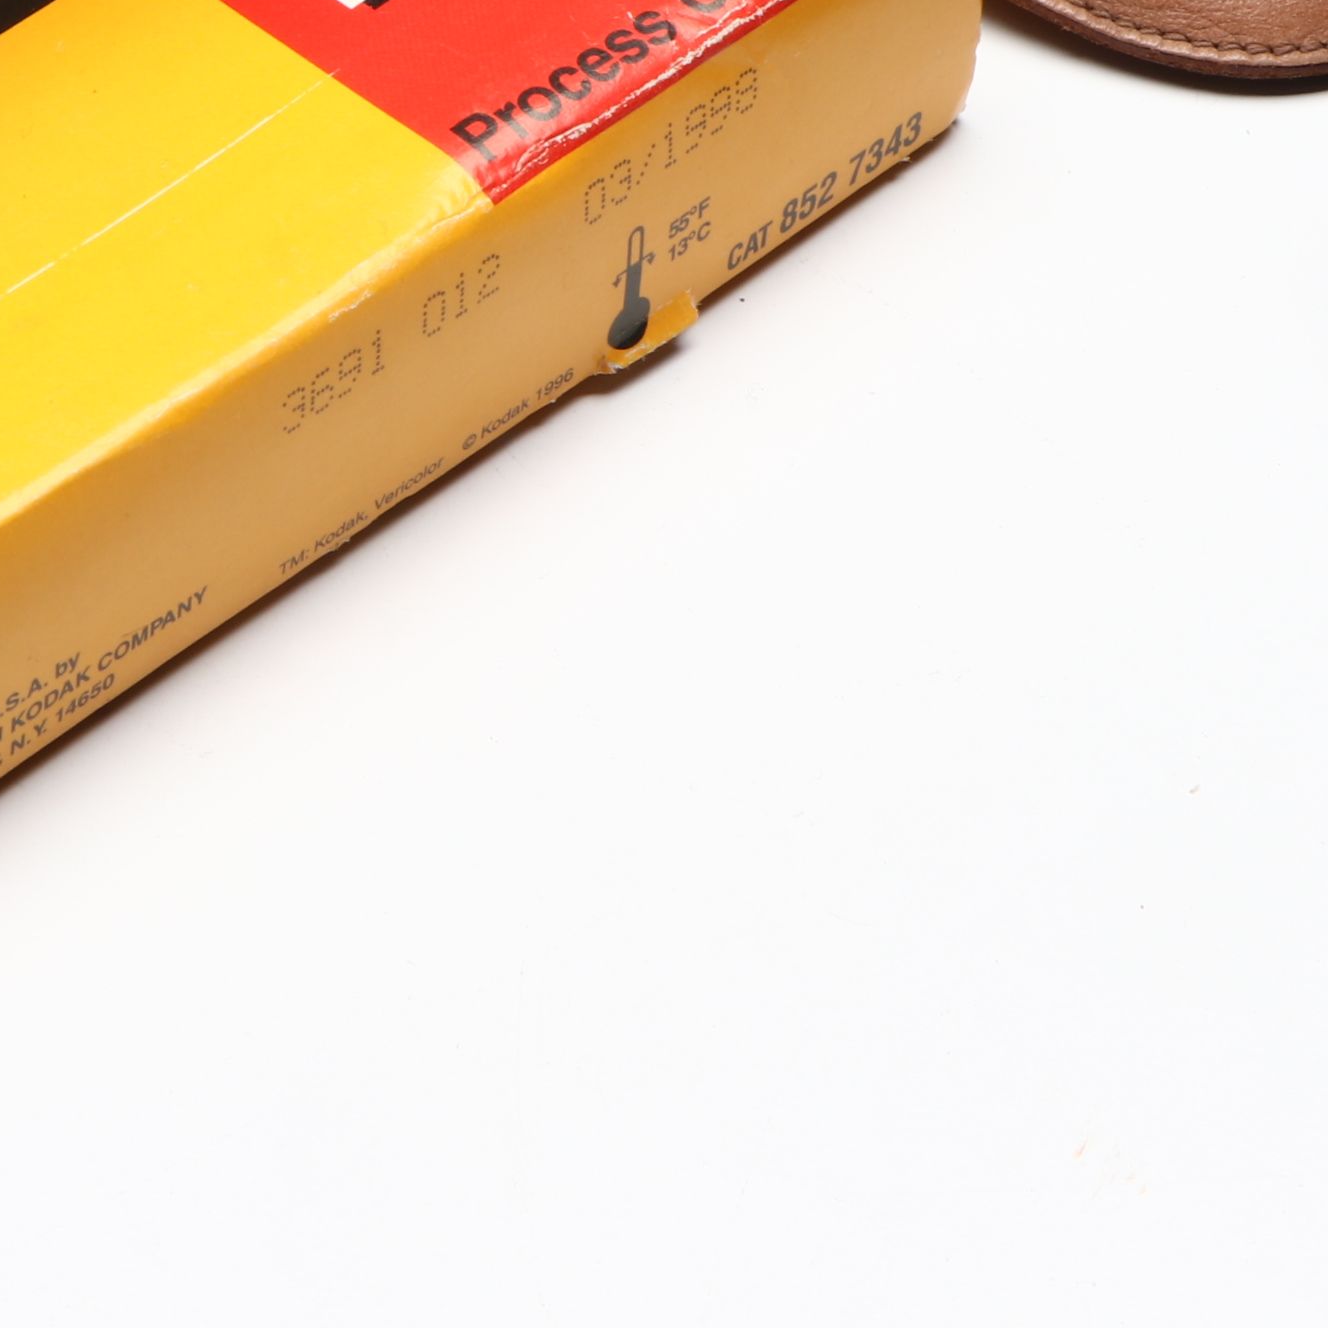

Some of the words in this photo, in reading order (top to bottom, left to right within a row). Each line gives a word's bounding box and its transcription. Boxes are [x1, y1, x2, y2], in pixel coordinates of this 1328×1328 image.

[450, 9, 677, 160] Process
[584, 67, 758, 225] 03/1998
[727, 220, 773, 271] CAT
[779, 171, 837, 234] 852
[848, 111, 923, 187] 7343
[423, 254, 500, 337] 012
[374, 457, 444, 509] Vericolor
[480, 399, 530, 439] Kodak
[536, 368, 574, 401] 1996
[11, 666, 91, 733] KODAK
[97, 586, 208, 672] COMPANY
[55, 652, 81, 679] by
[56, 673, 116, 723] 14650
